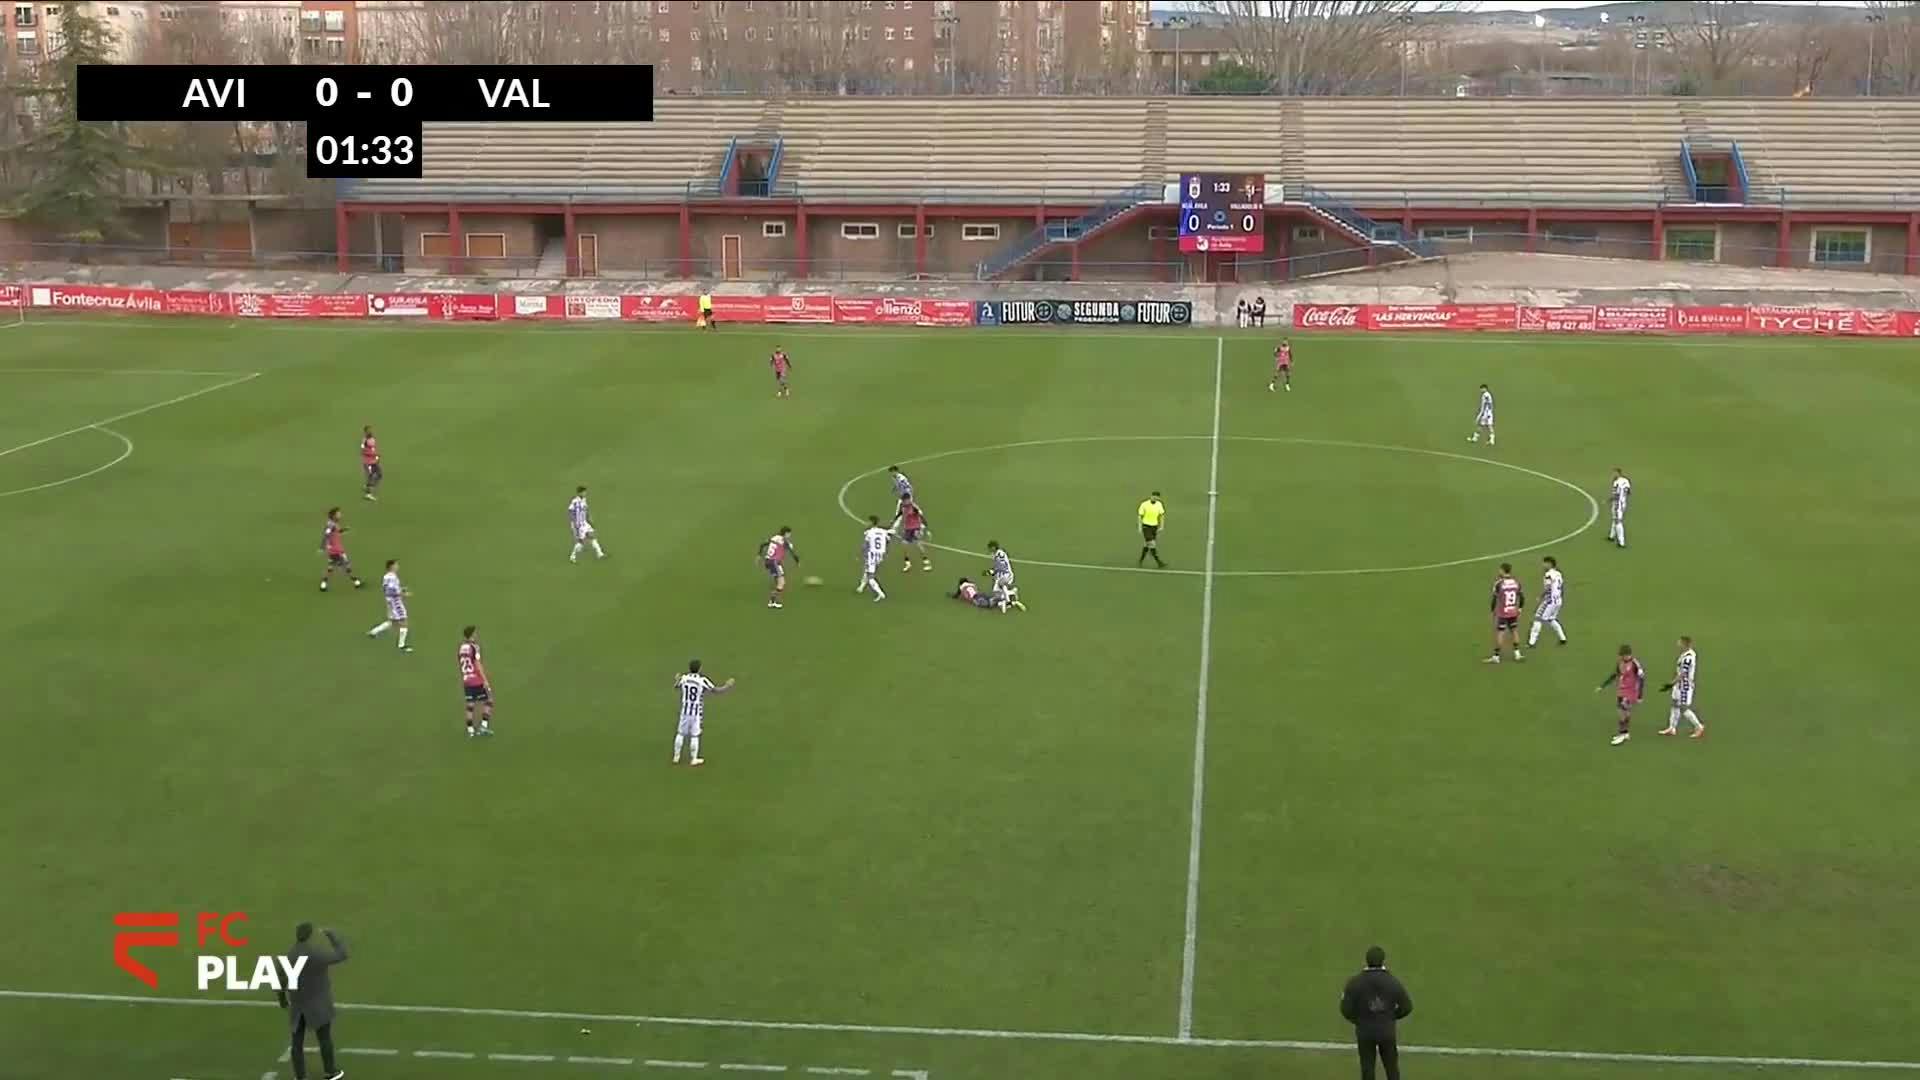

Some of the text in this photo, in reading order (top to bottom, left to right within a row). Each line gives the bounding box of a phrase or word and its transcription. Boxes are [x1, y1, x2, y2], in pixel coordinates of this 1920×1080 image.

[1213, 183, 1230, 193] 1:33
[1188, 214, 1200, 231] 0
[1242, 214, 1255, 231] 0
[53, 291, 124, 308] Fontecruz
[126, 292, 161, 311] Ávila
[1074, 303, 1119, 316] SEGUNDA
[875, 536, 881, 550] 6
[1504, 591, 1516, 606] 19
[684, 685, 698, 702] 18
